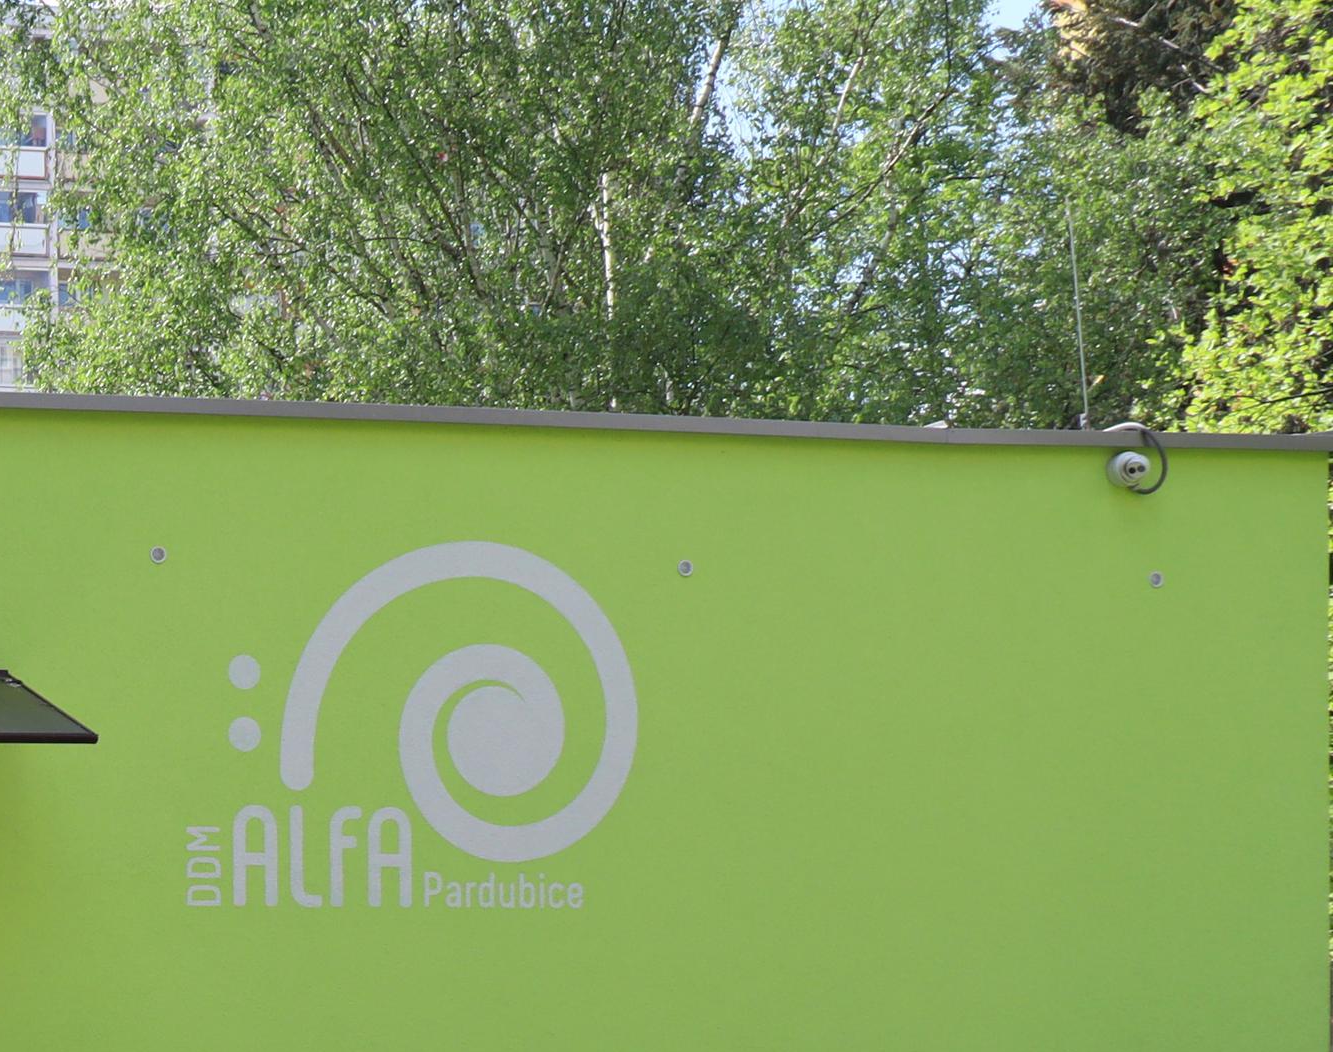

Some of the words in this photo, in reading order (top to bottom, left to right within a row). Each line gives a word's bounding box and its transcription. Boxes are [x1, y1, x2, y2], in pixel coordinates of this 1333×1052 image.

[185, 825, 222, 907] DDM
[233, 804, 412, 908] ALFA
[423, 871, 584, 909] Pardubice
